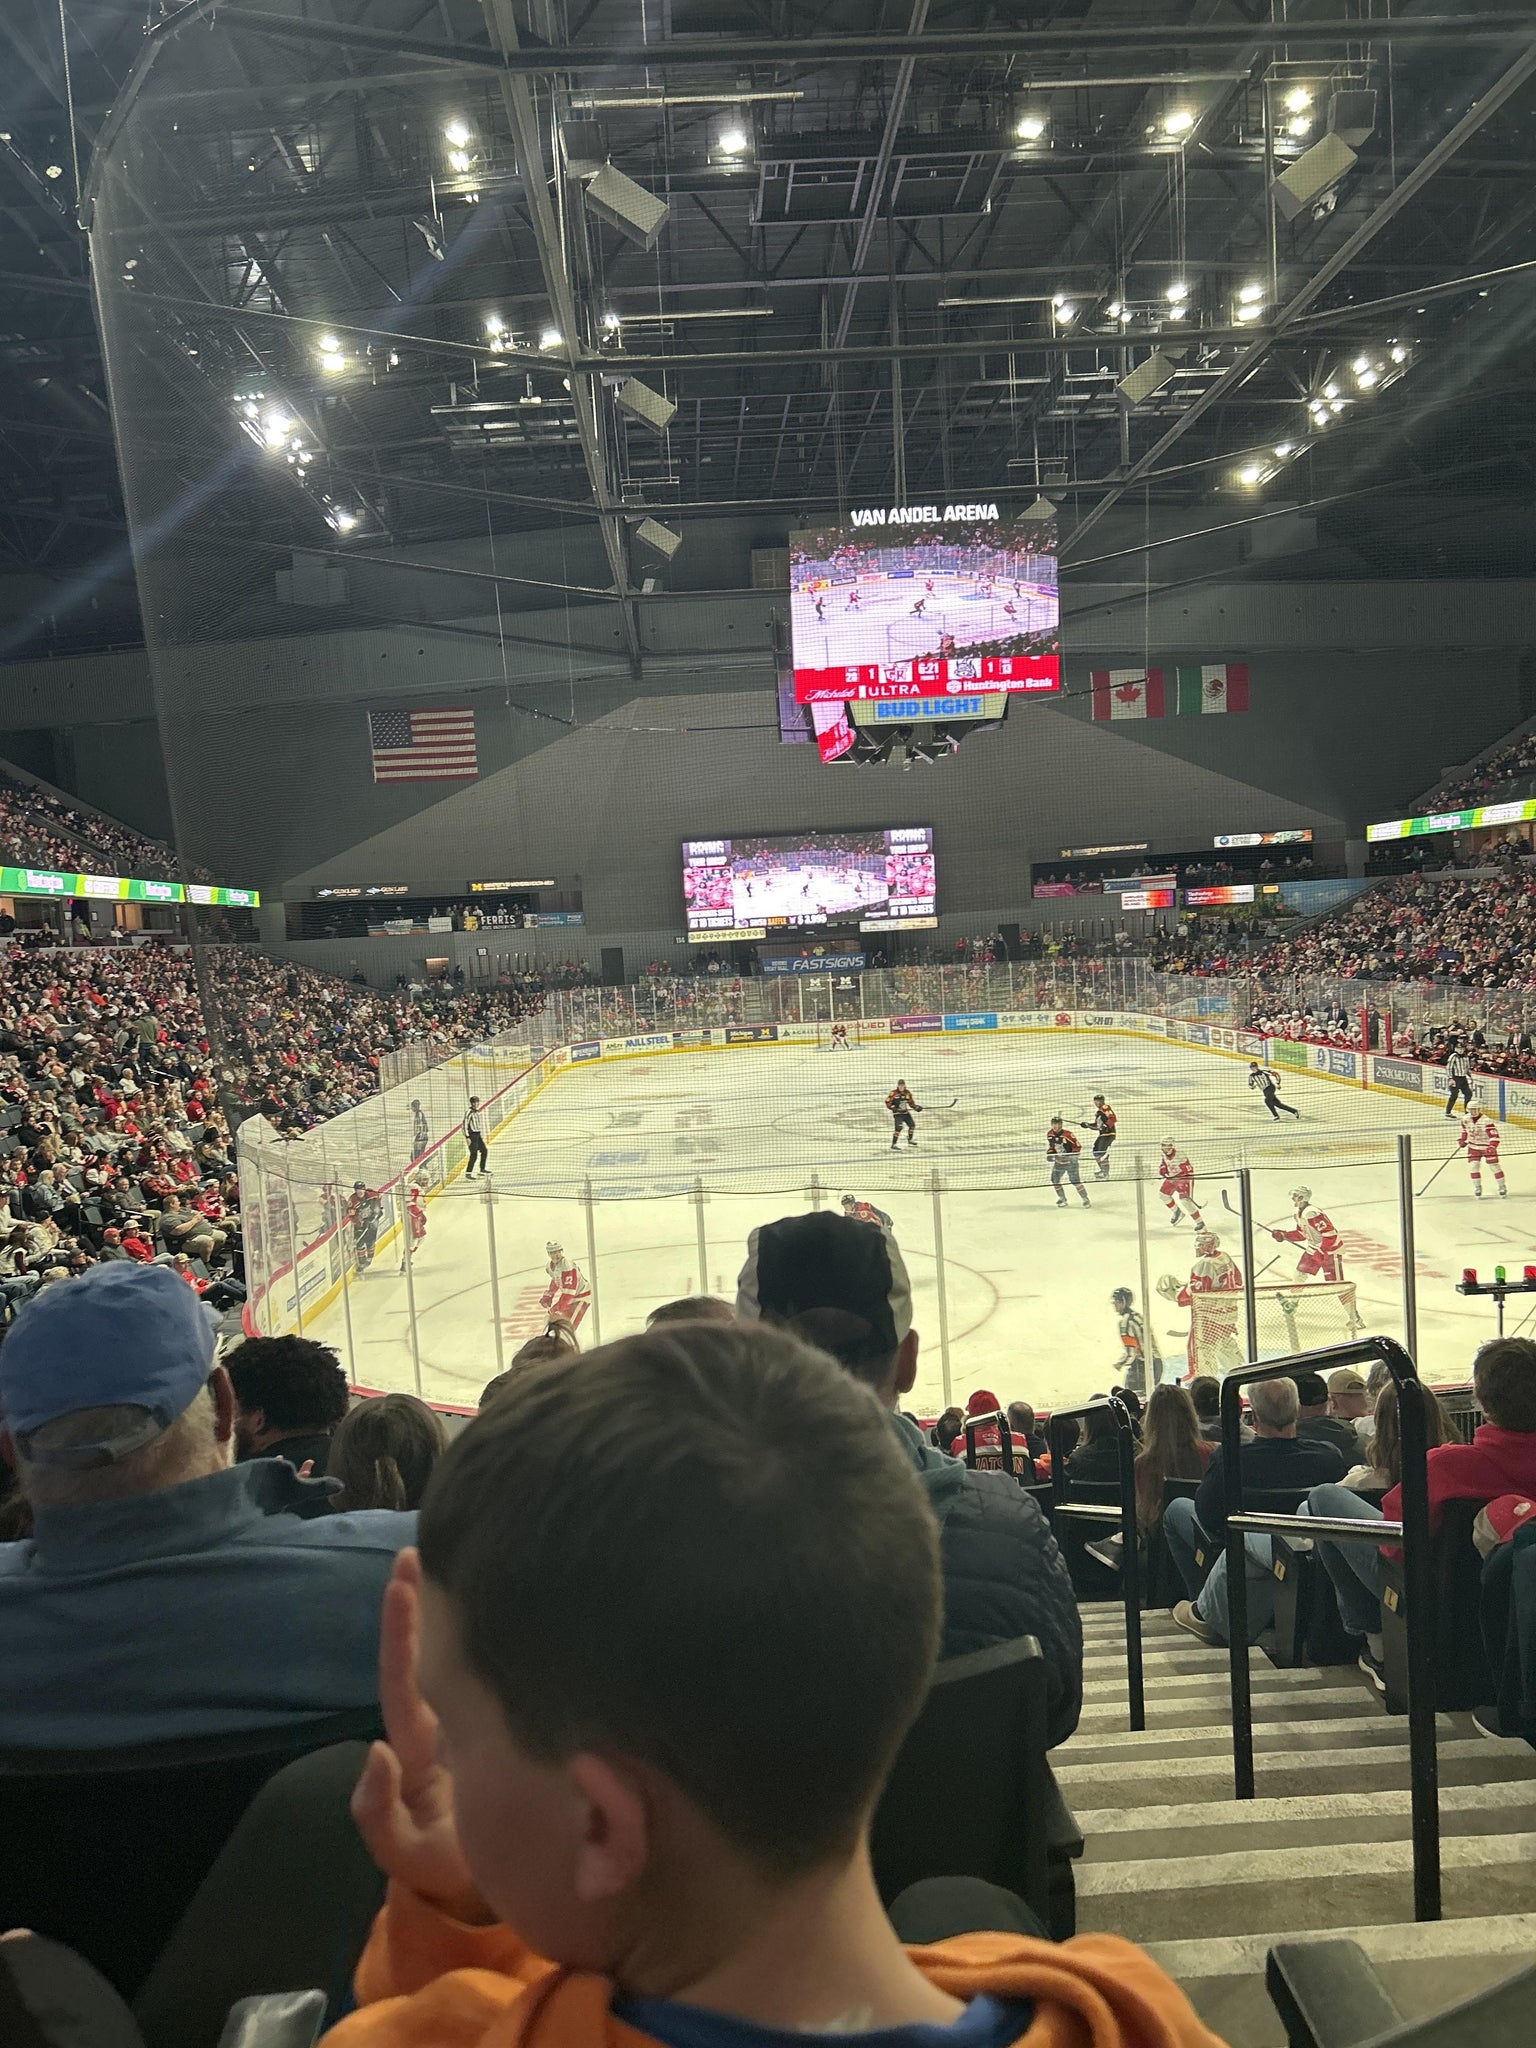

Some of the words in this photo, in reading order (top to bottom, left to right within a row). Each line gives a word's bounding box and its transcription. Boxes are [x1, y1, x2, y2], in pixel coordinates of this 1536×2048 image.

[850, 509, 886, 527] VAN
[887, 506, 943, 525] ANDEL
[943, 504, 1000, 522] ARENA
[868, 684, 921, 697] ULTRA
[963, 679, 1025, 692] Huntington
[1025, 677, 1053, 688] Bank
[804, 687, 857, 701] Michelob
[877, 701, 921, 718] BUD
[922, 697, 982, 715] LIGHT
[481, 915, 516, 925] FERRIS
[792, 956, 864, 971] FASTSIGNS
[626, 1039, 646, 1047] MILL
[647, 1036, 670, 1045] STEEL
[1434, 1076, 1447, 1091] BU
[1314, 1220, 1328, 1232] 23
[975, 1457, 1024, 1475] ATSN
